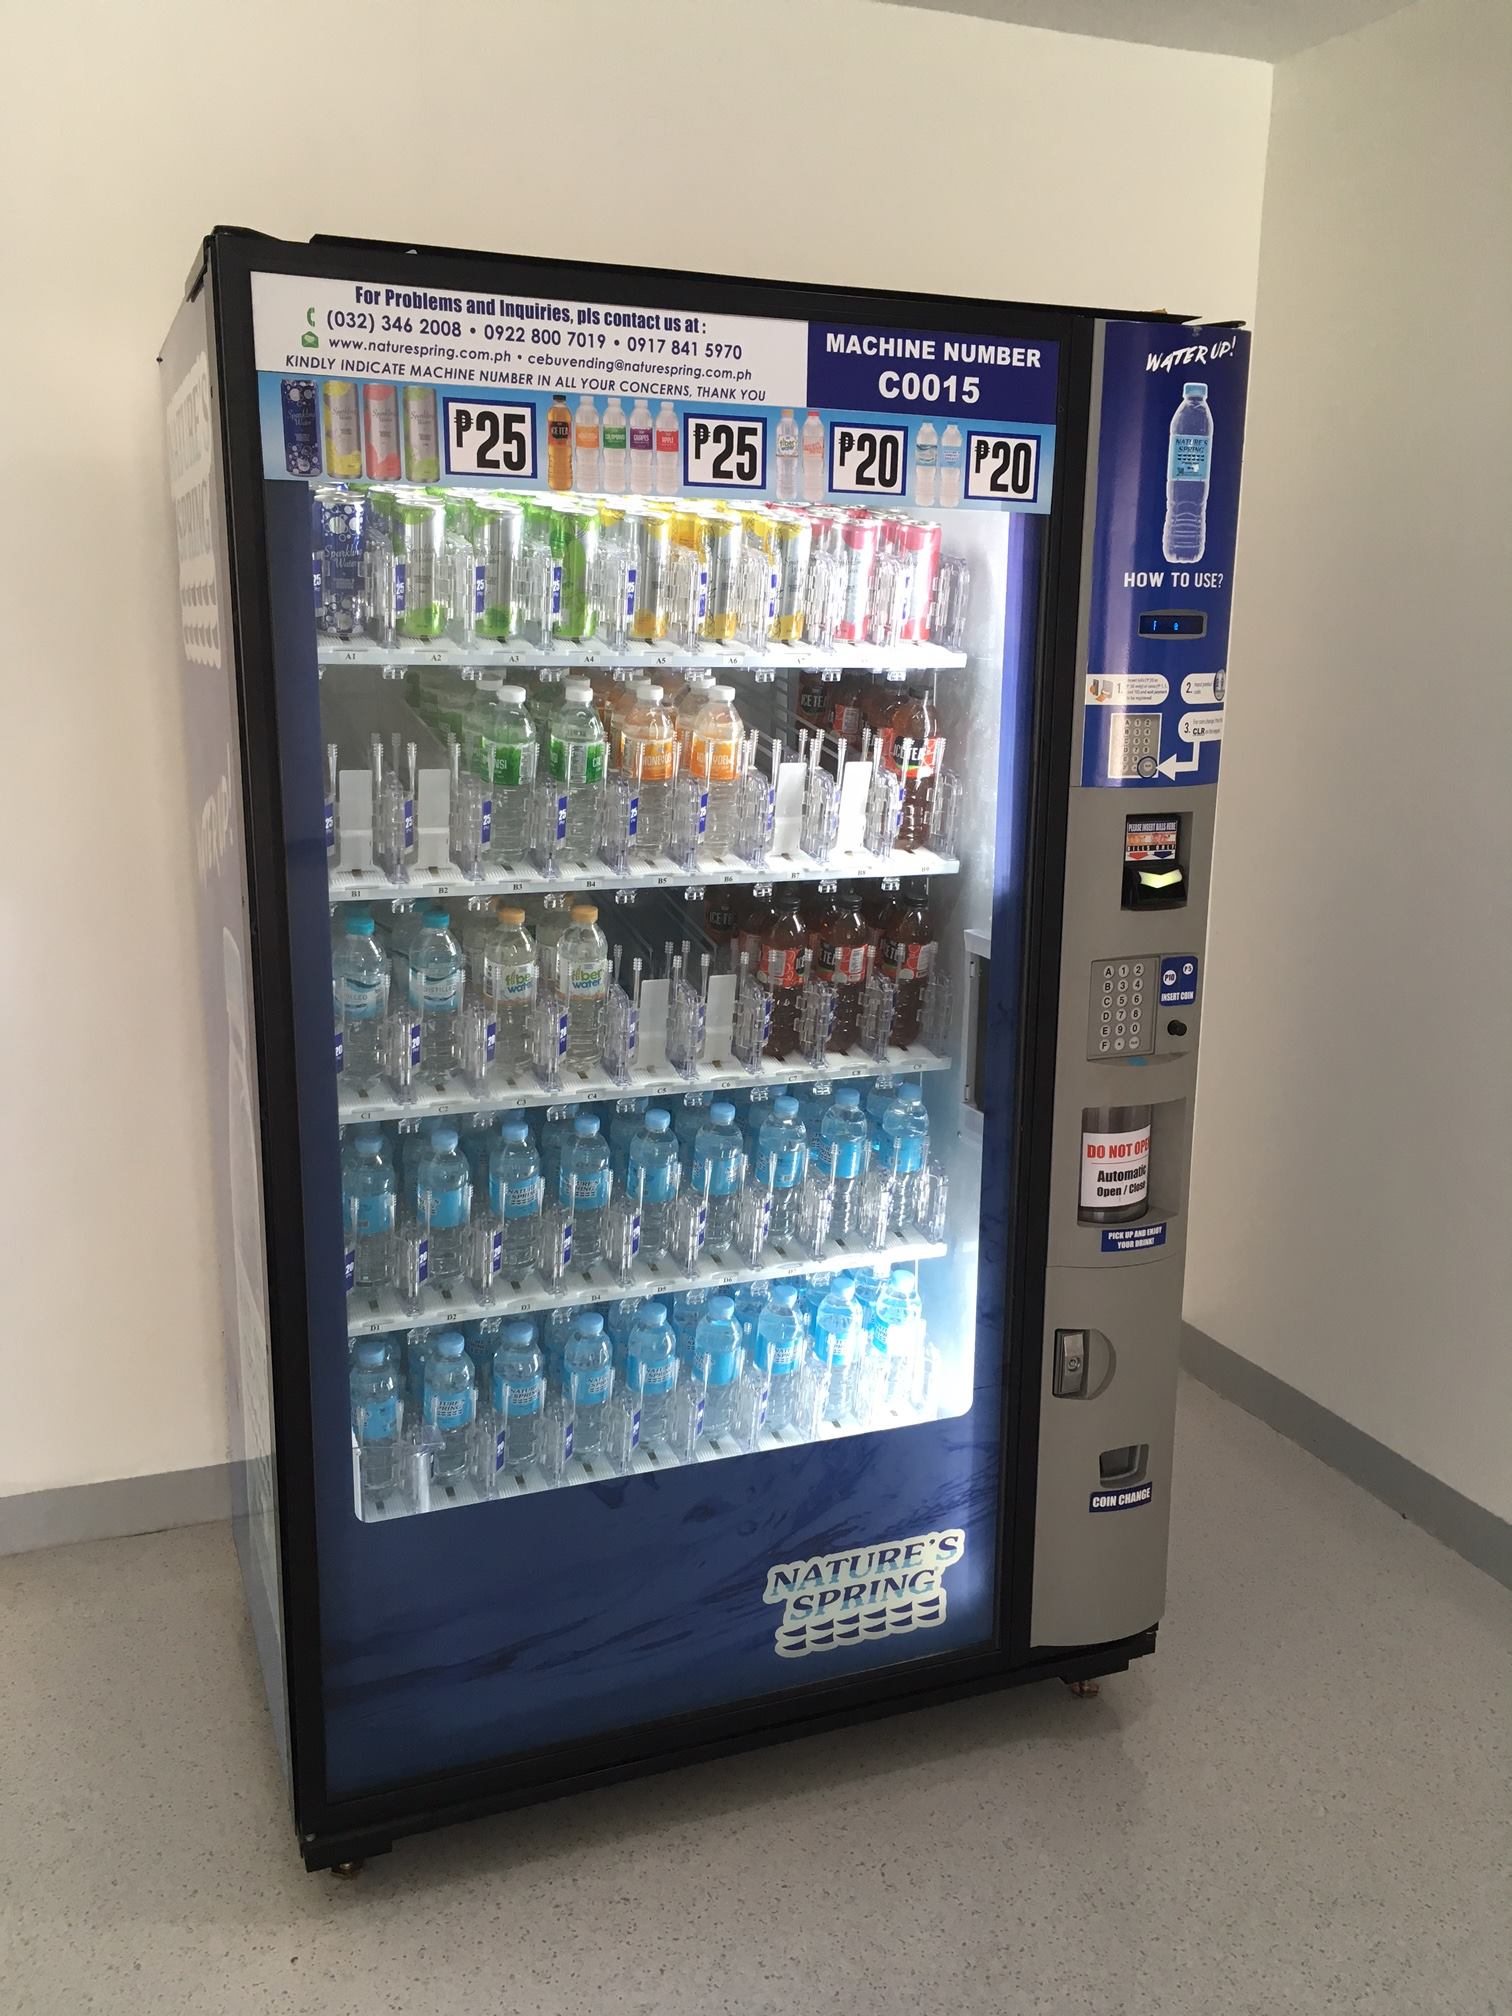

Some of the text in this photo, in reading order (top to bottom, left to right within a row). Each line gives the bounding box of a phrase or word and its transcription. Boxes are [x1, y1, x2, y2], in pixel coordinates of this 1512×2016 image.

[355, 286, 380, 305] For
[385, 289, 462, 313] Problems
[467, 298, 495, 316] and
[500, 299, 574, 324] Inquiries,
[577, 307, 600, 325] pls
[604, 311, 660, 330] contact
[664, 317, 681, 332] us
[327, 310, 742, 360] (032) 346 2008 0922 800 7019 0917 841 5970
[826, 332, 1041, 368] MACHINE NUMBER
[1145, 336, 1236, 373] WATER UP!
[329, 338, 752, 382] www.naturespring.com.ph cebuvending@naturespring.com.ph
[286, 355, 766, 401] KINDLY INDICATE MACHINE NUMBER IN ALL YOUR CONCERNS, THANK YOU
[878, 370, 980, 404] C0015
[1124, 572, 1224, 588] HOW TO USE?
[345, 653, 356, 661] A1
[509, 655, 520, 663] A3
[1192, 727, 1206, 735] CLR
[513, 883, 523, 891] B3
[586, 880, 596, 888] B4
[1181, 991, 1194, 1000] COIN
[361, 1112, 371, 1120] C1
[1087, 1136, 1151, 1159] DO NOT OPE
[1097, 1165, 1147, 1183] Automatic
[1096, 1186, 1122, 1197] Open
[1129, 1180, 1146, 1194] Close
[1108, 1231, 1124, 1240] PICK
[1125, 1230, 1134, 1239] UP
[1134, 1229, 1146, 1237] AND
[1117, 1240, 1134, 1249] YOUR
[1092, 1487, 1151, 1508] COIN CHANGE
[771, 1535, 959, 1596] NATURE'S
[790, 1569, 935, 1621] SPRING
